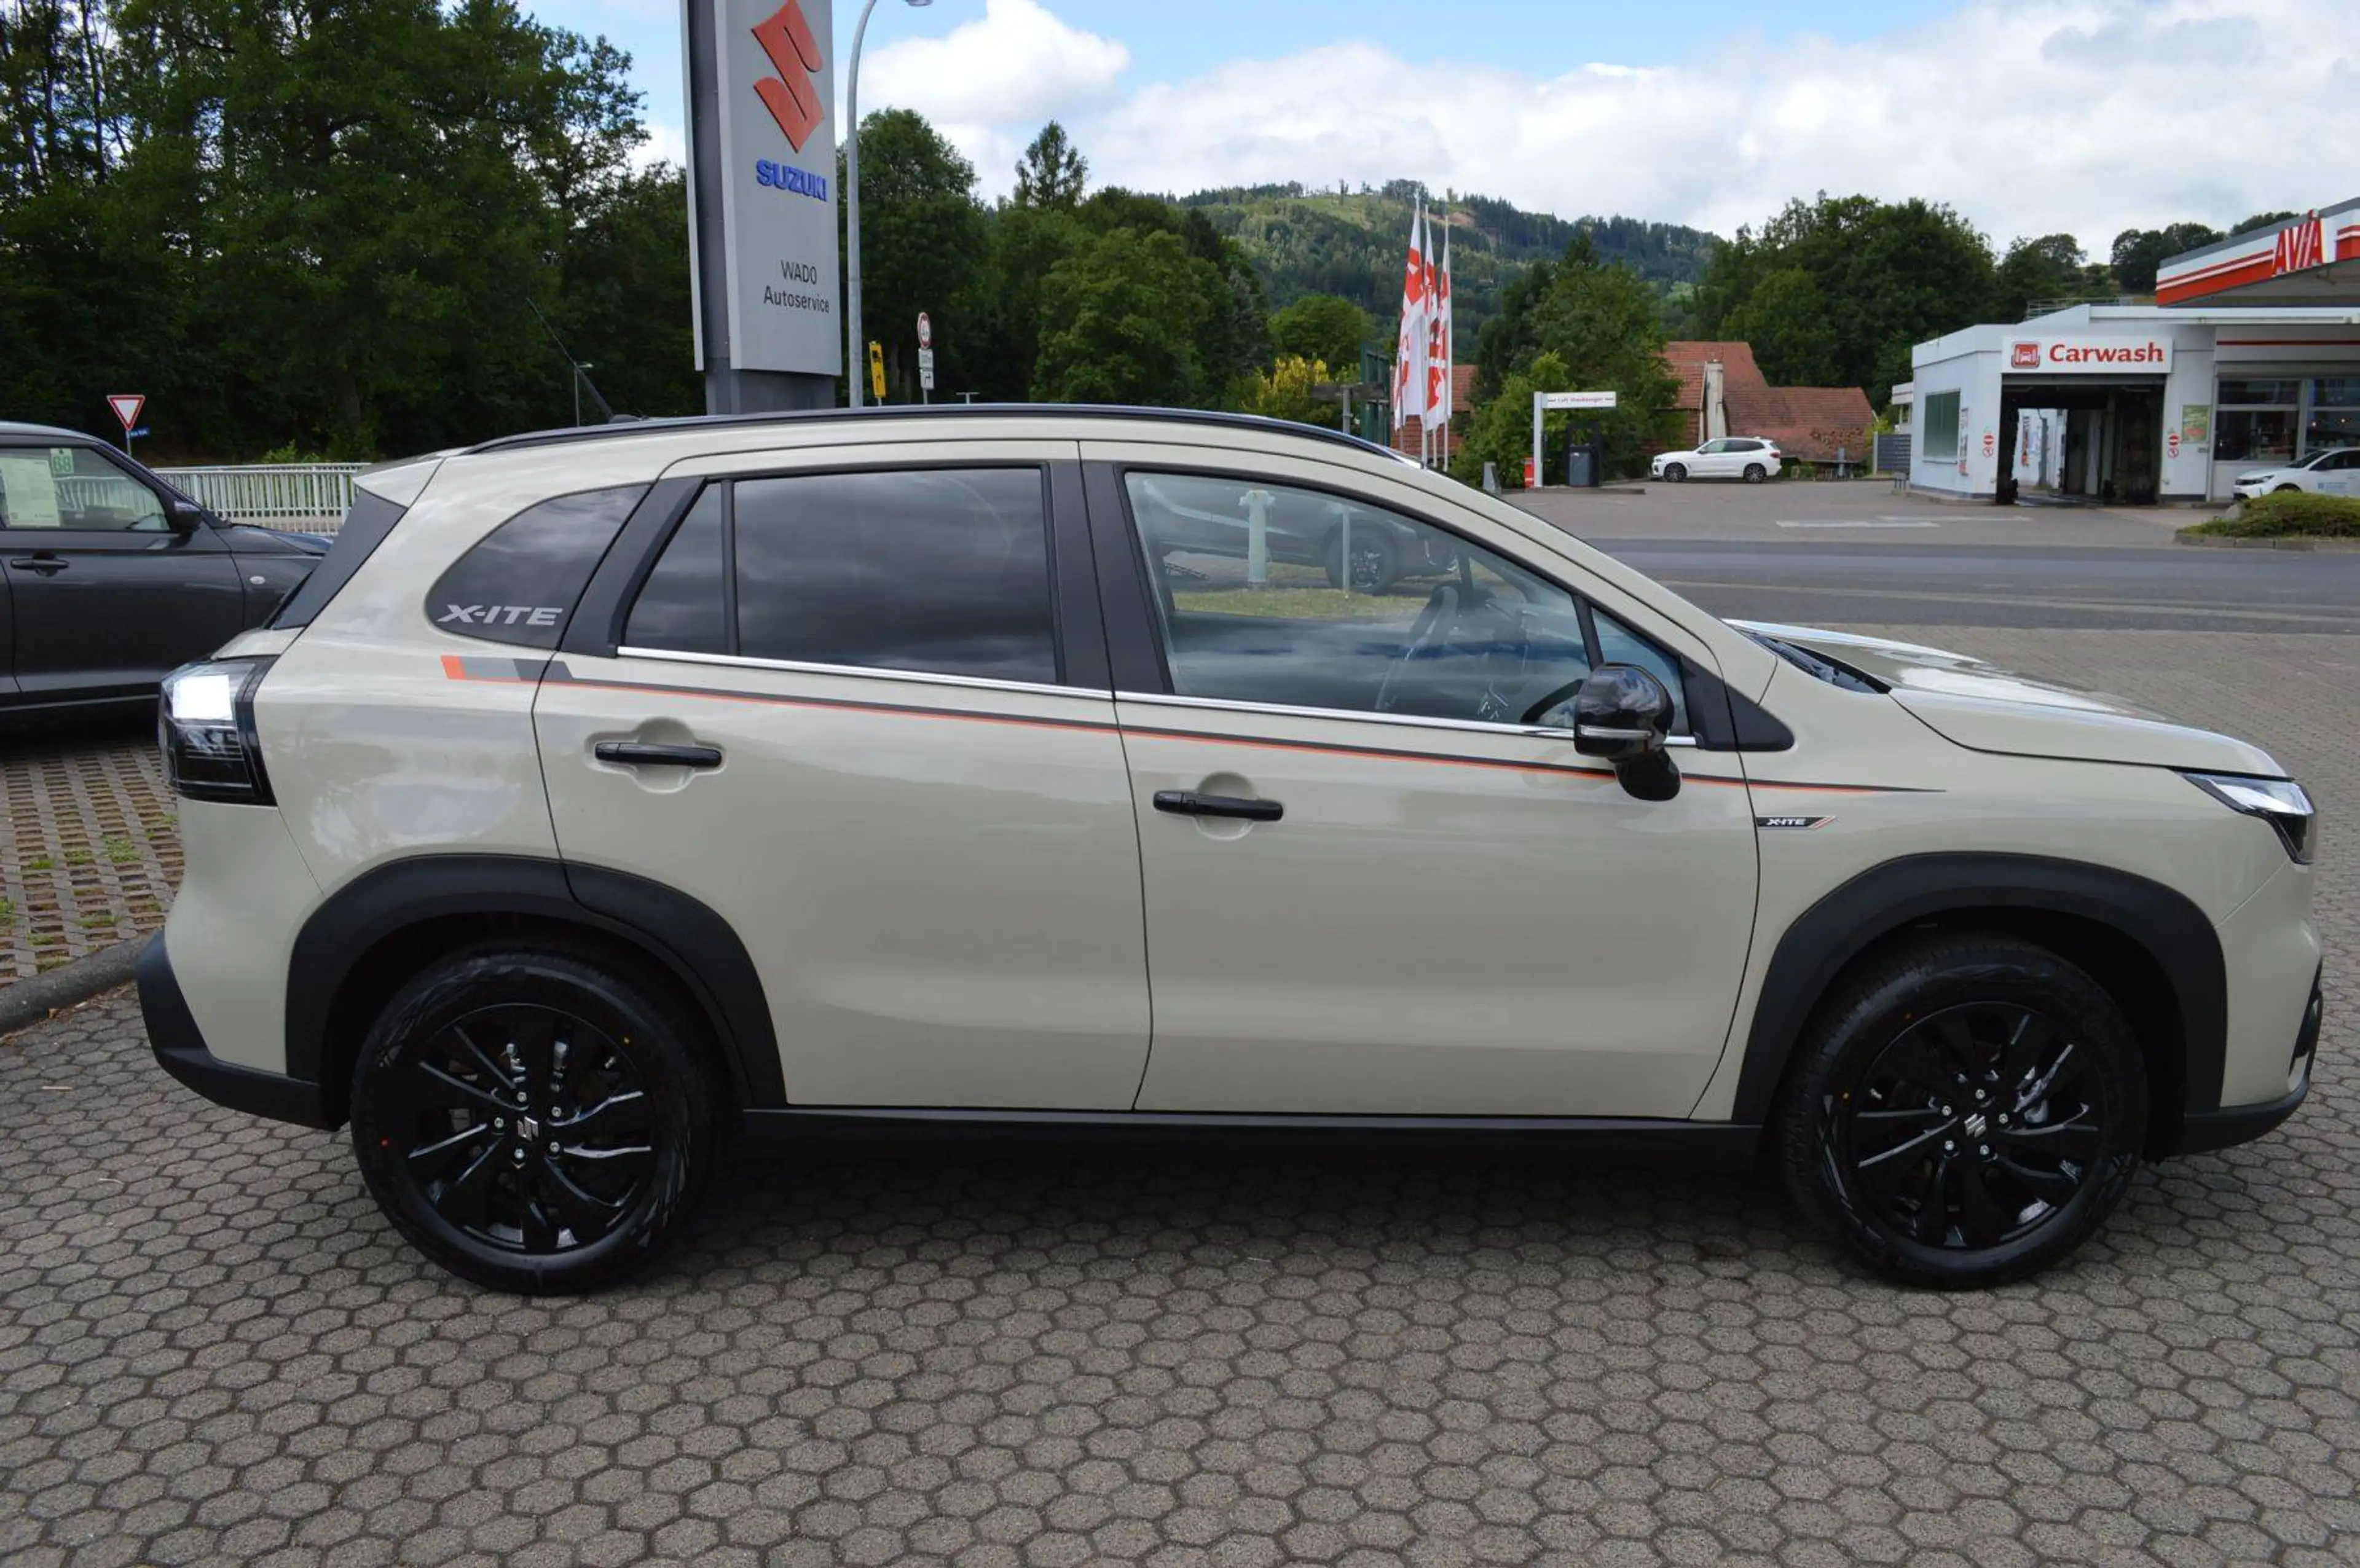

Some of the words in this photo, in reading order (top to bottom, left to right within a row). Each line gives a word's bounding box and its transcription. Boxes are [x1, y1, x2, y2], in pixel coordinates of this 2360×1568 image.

[756, 159, 827, 202] SUZUKI
[781, 259, 817, 284] WADO
[764, 285, 829, 313] Autoservice
[2050, 342, 2163, 363] Carwash
[437, 605, 563, 625] X-ITE
